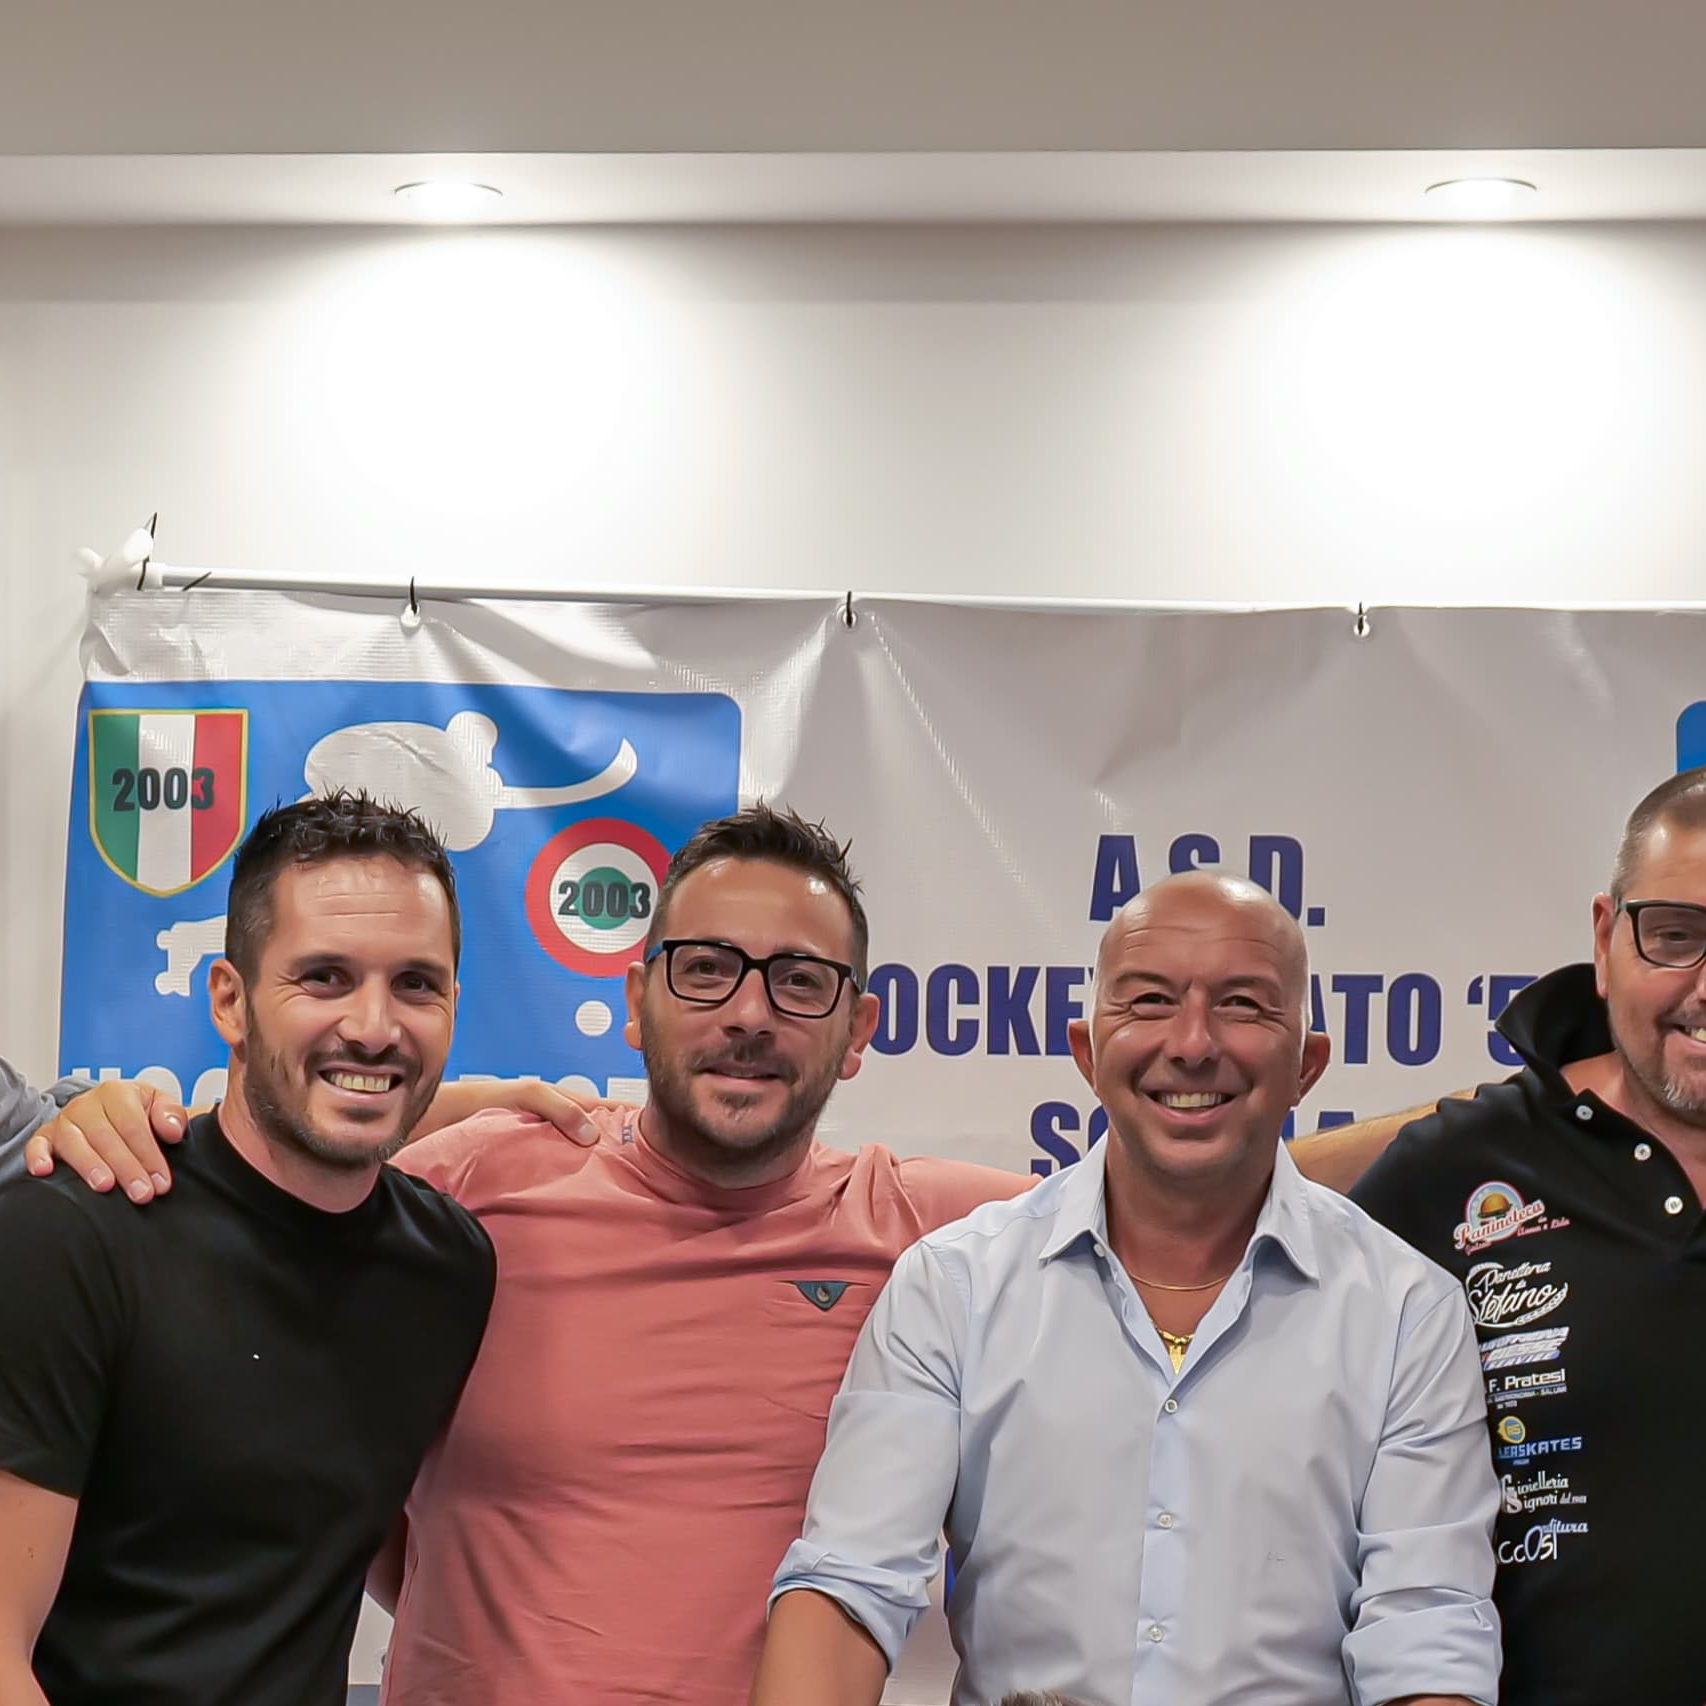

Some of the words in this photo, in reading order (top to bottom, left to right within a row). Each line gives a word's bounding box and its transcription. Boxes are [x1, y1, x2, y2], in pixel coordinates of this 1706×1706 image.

[111, 767, 215, 812] 2003
[558, 879, 651, 919] 2003
[867, 963, 1095, 1057] OCKE
[1453, 1199, 1545, 1250] Paninoteca
[1468, 1282, 1558, 1323] Stefano
